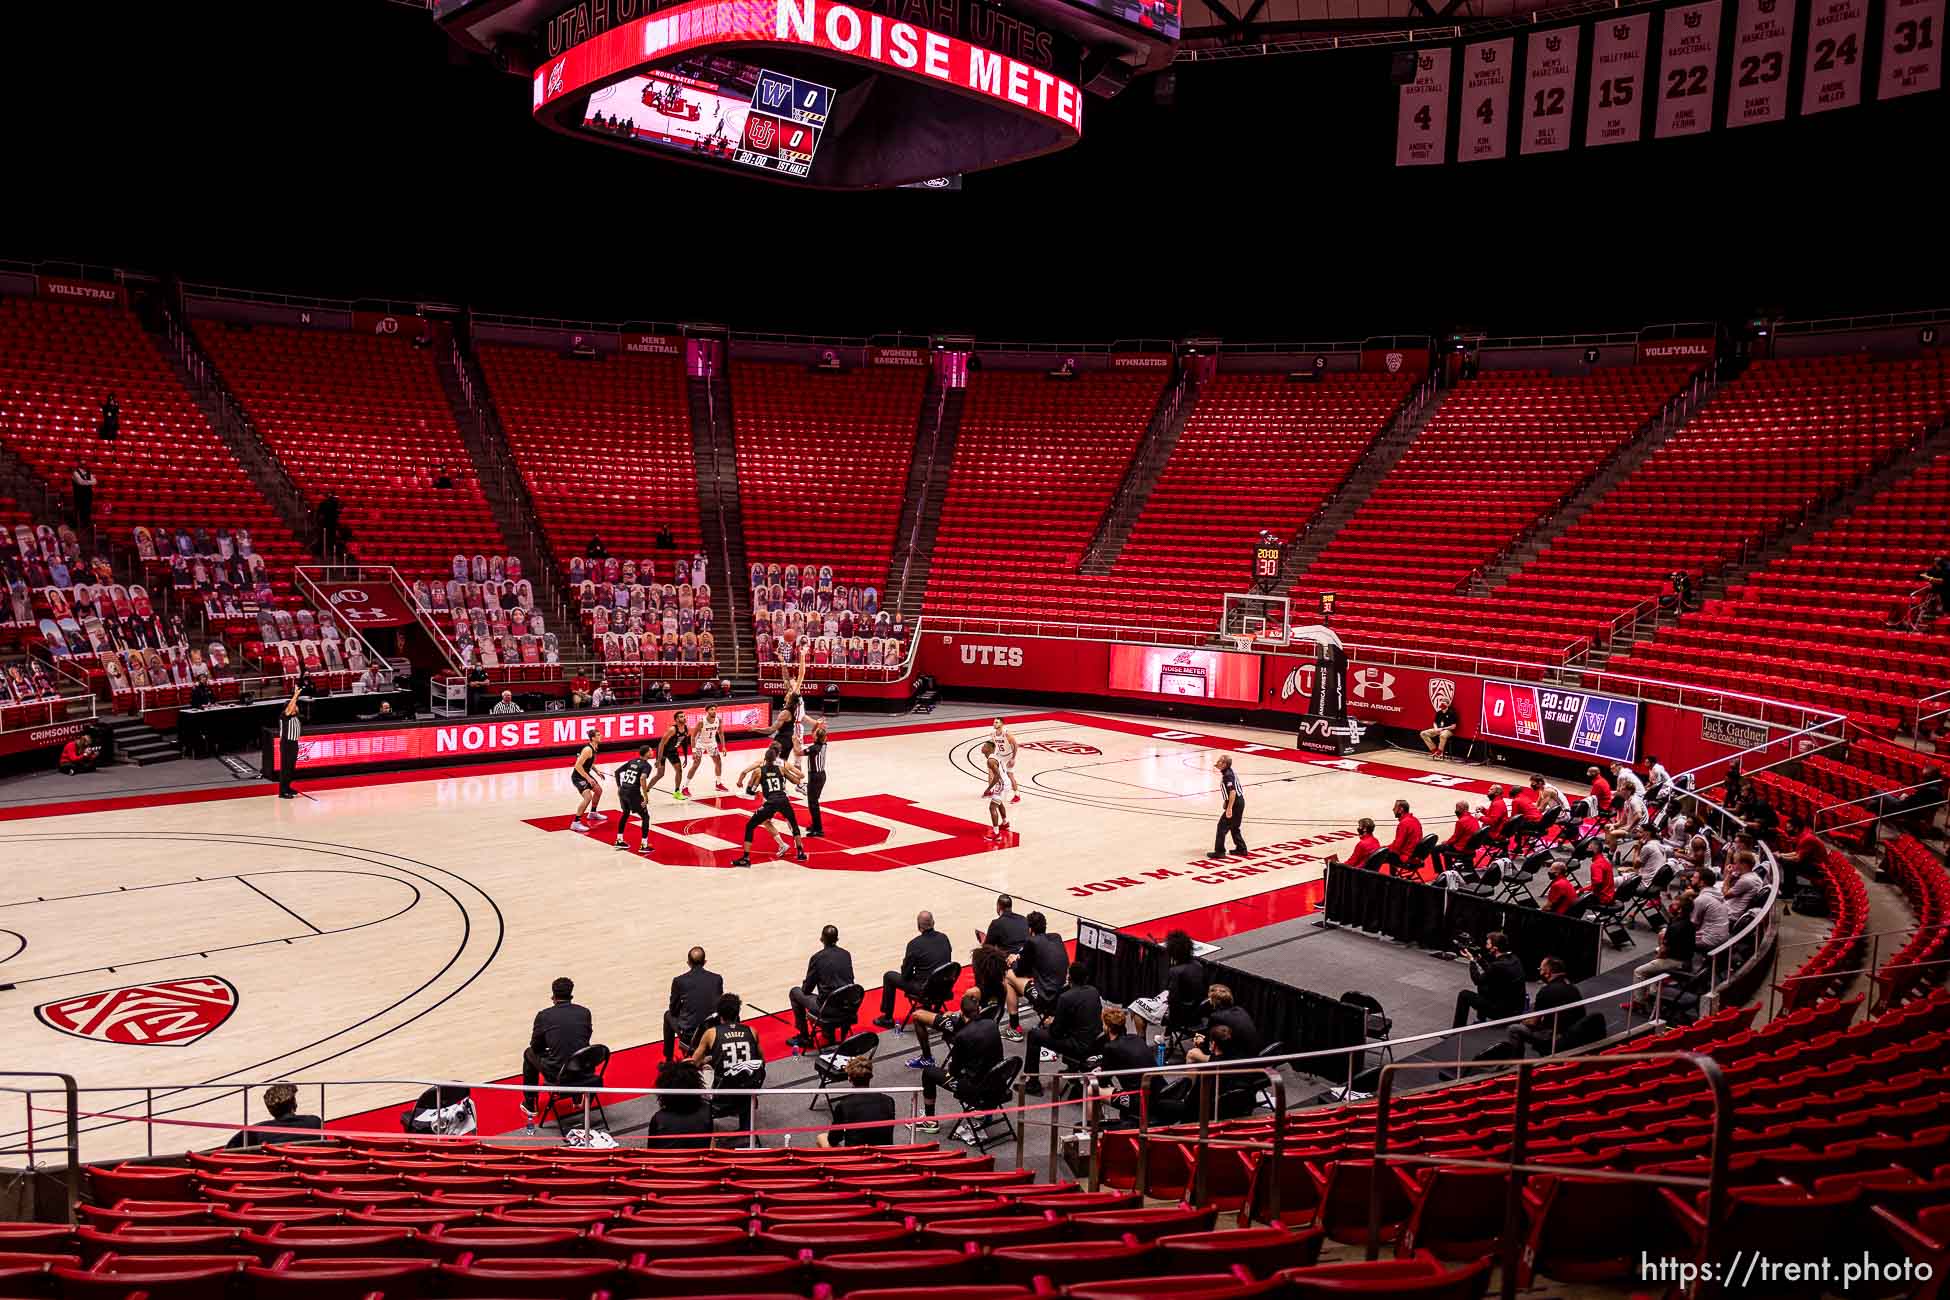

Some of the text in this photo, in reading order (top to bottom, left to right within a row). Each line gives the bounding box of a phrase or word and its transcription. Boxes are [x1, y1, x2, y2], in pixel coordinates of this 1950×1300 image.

[548, 0, 609, 57] UTAH
[968, 4, 1053, 66] UTES
[1894, 16, 1933, 54] 31
[775, 0, 950, 79] NOISE
[1814, 33, 1858, 72] 24
[1739, 51, 1783, 88] 23
[1666, 65, 1709, 99] 22
[803, 90, 818, 108] 0
[1599, 76, 1635, 108] 15
[1476, 98, 1493, 124] 4
[1533, 87, 1565, 118] 12
[1414, 105, 1432, 130] 4
[789, 131, 804, 147] 0
[739, 152, 767, 166] 20:00
[776, 160, 790, 171] 1ST
[789, 162, 808, 175] HALF
[48, 284, 116, 300] VOLLEYBALL
[301, 312, 310, 324] N
[641, 336, 666, 344] MEN'S
[1922, 330, 1933, 342] U
[627, 343, 679, 354] BASKETBALL
[880, 349, 918, 357] WOMEN'S
[1588, 351, 1596, 360] T
[1645, 346, 1708, 357] VOLLEYBALL
[874, 356, 923, 366] BASKETBALL
[1115, 358, 1168, 367] GYMNASTICS
[1316, 358, 1324, 368] S
[1257, 548, 1279, 560] 20:00
[1259, 559, 1276, 575] 30
[960, 644, 1024, 667] UTES
[1162, 665, 1206, 675] NOISE METER
[1345, 700, 1401, 713] UNDER ARMOUR
[1493, 699, 1505, 717] 0
[1541, 692, 1580, 713] 20:00
[1544, 710, 1574, 724] 1ST HALF
[30, 726, 69, 741] CRIMSON
[436, 720, 540, 752] NOISE
[553, 714, 655, 744] METER
[1613, 717, 1626, 737] 0
[1703, 718, 1766, 742] Jack Gardner
[1703, 730, 1718, 739] HEAD
[1718, 733, 1738, 744] COACH
[623, 769, 638, 785] 55
[766, 778, 781, 793] 13
[1066, 830, 1358, 897] JON M. HUNTSMAN
[1191, 852, 1323, 885] CENTER
[721, 1041, 751, 1069] 33
